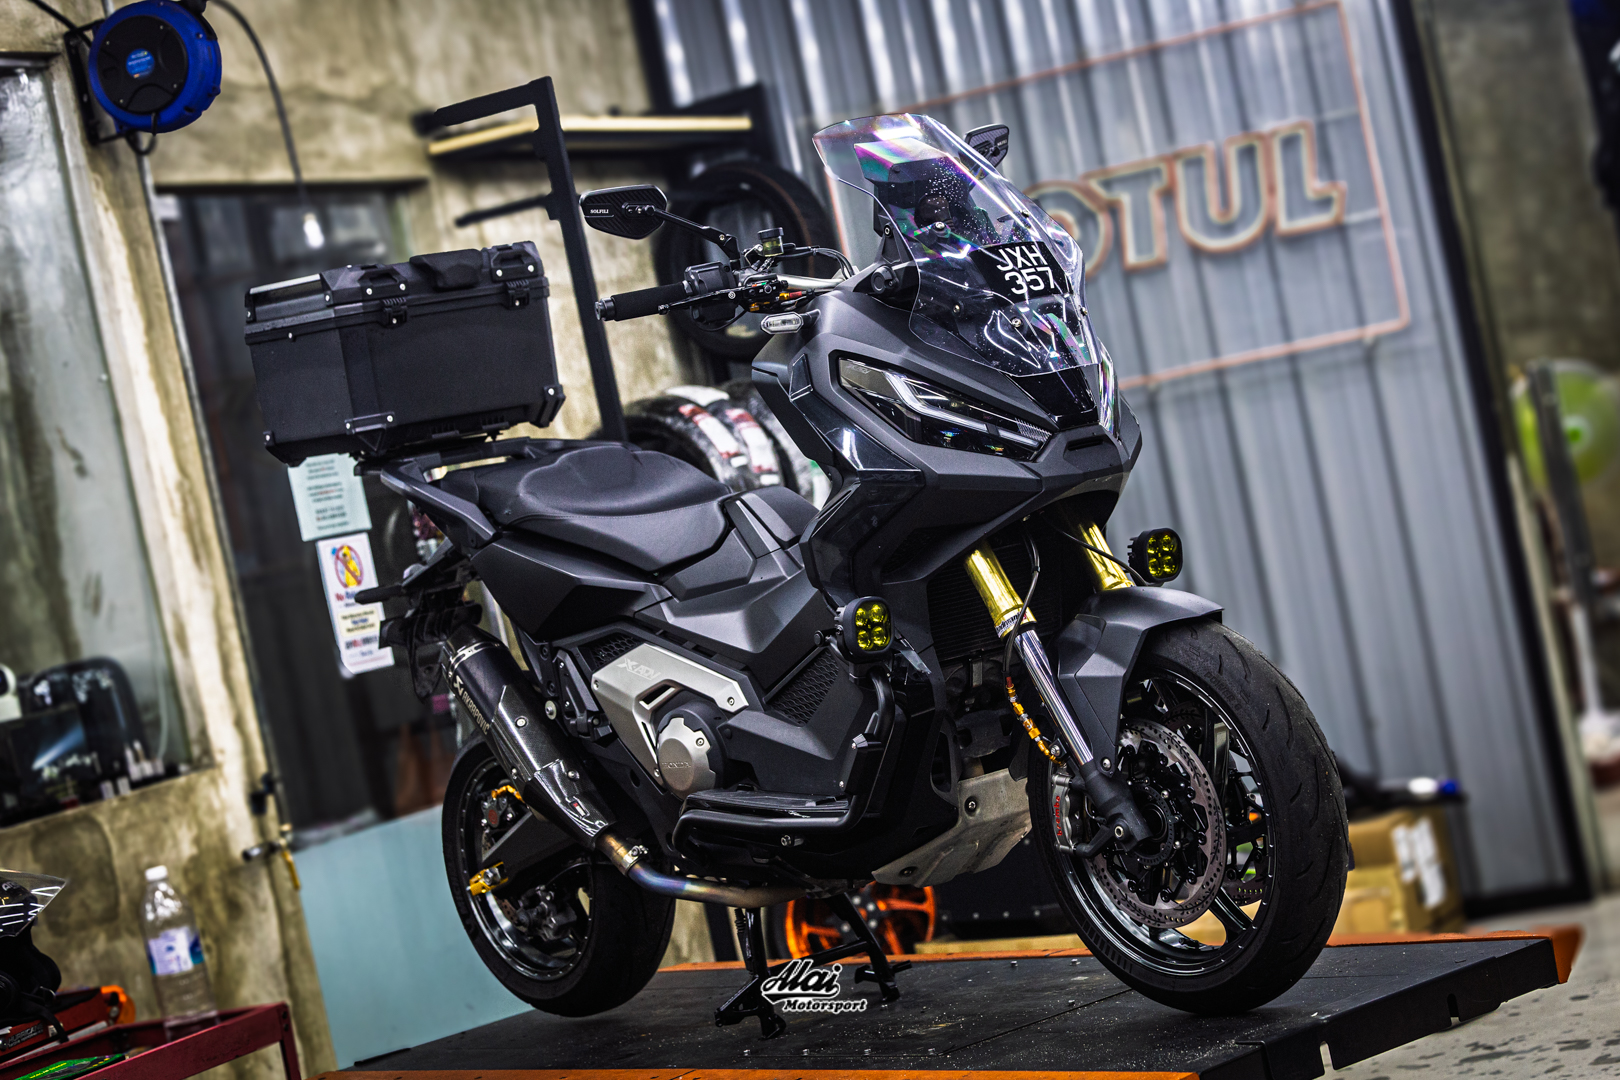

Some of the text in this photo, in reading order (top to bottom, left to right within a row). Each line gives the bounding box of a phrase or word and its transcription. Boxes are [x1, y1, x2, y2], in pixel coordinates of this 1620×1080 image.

[1021, 119, 1349, 283] OTUL
[996, 244, 1048, 271] JXH
[1004, 266, 1055, 295] 357
[1053, 795, 1063, 836] brembo
